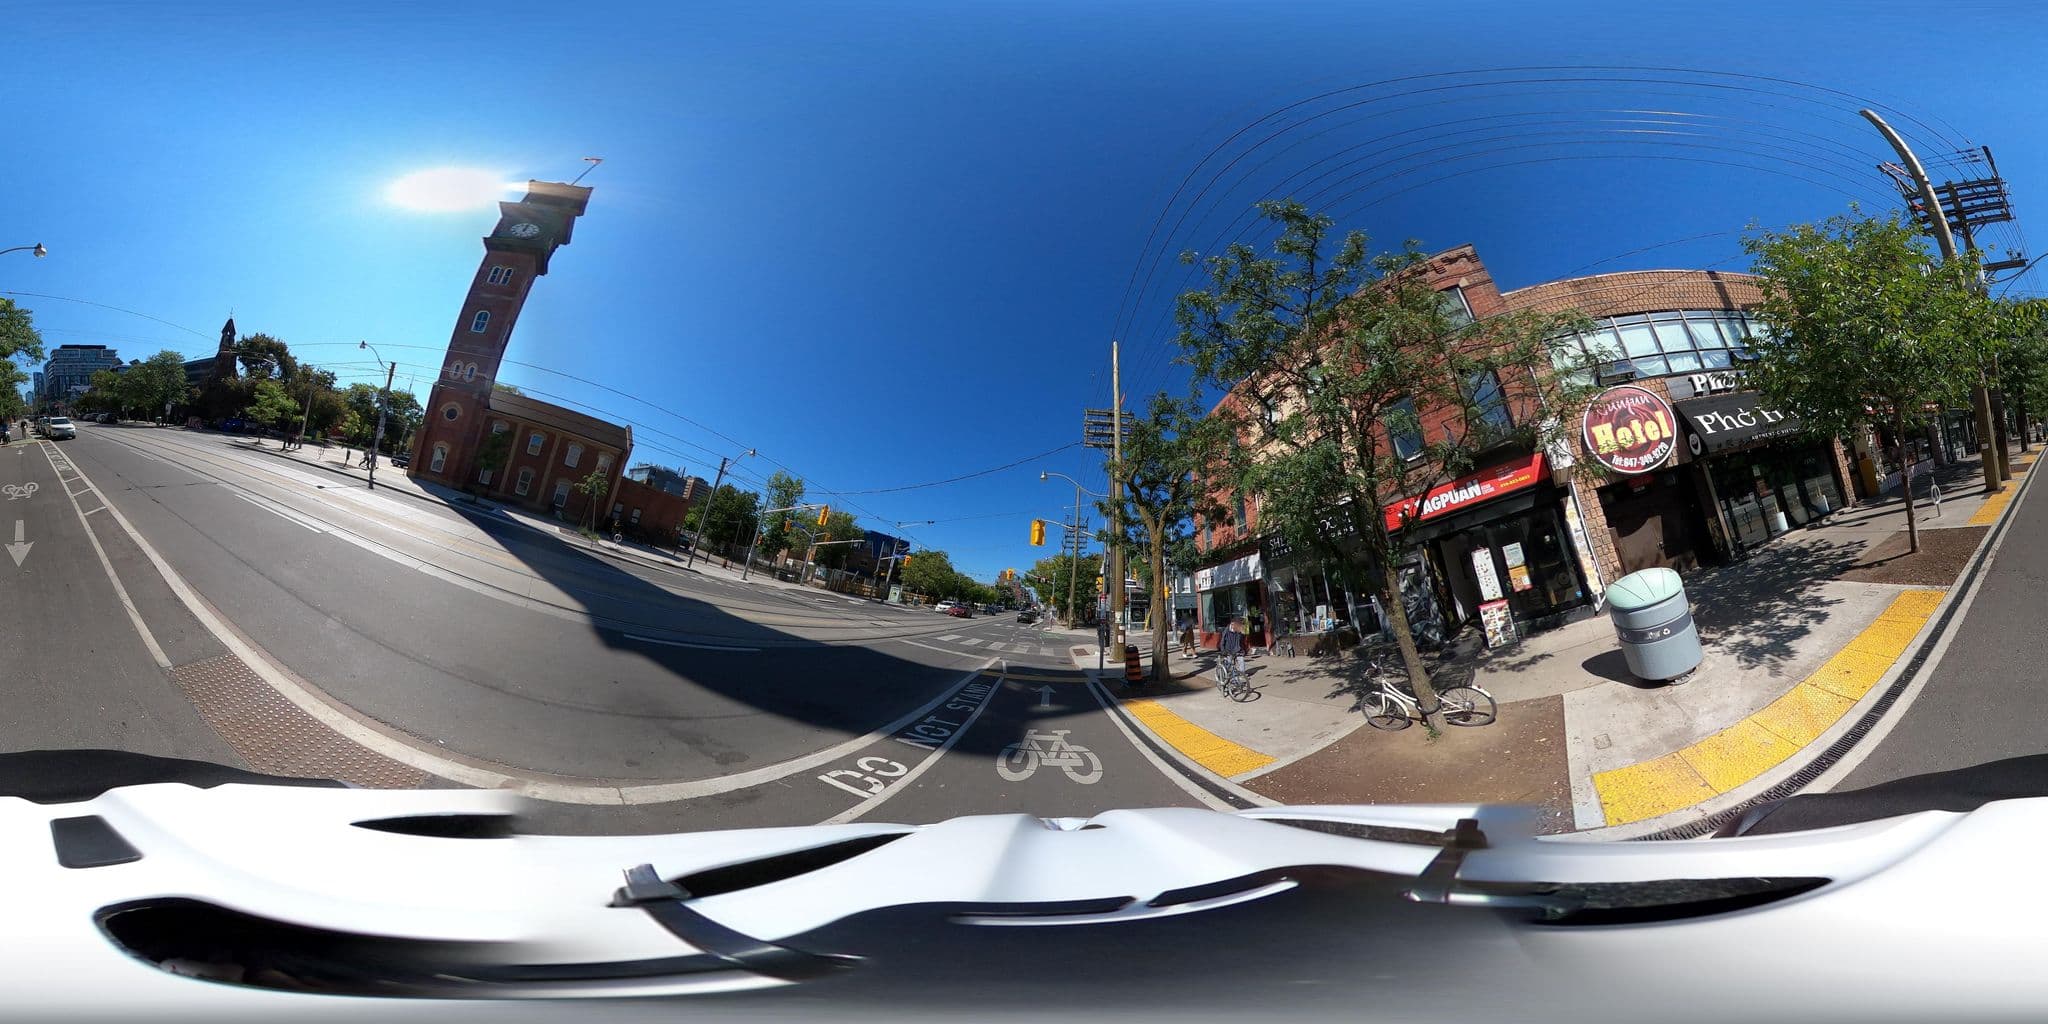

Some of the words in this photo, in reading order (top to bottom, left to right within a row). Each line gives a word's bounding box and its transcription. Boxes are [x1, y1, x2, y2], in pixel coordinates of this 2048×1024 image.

[1591, 410, 1672, 455] Hotel
[1414, 479, 1482, 517] AGPUAN
[816, 756, 909, 799] DO
[895, 715, 960, 750] NOT
[946, 682, 993, 713] STAND
